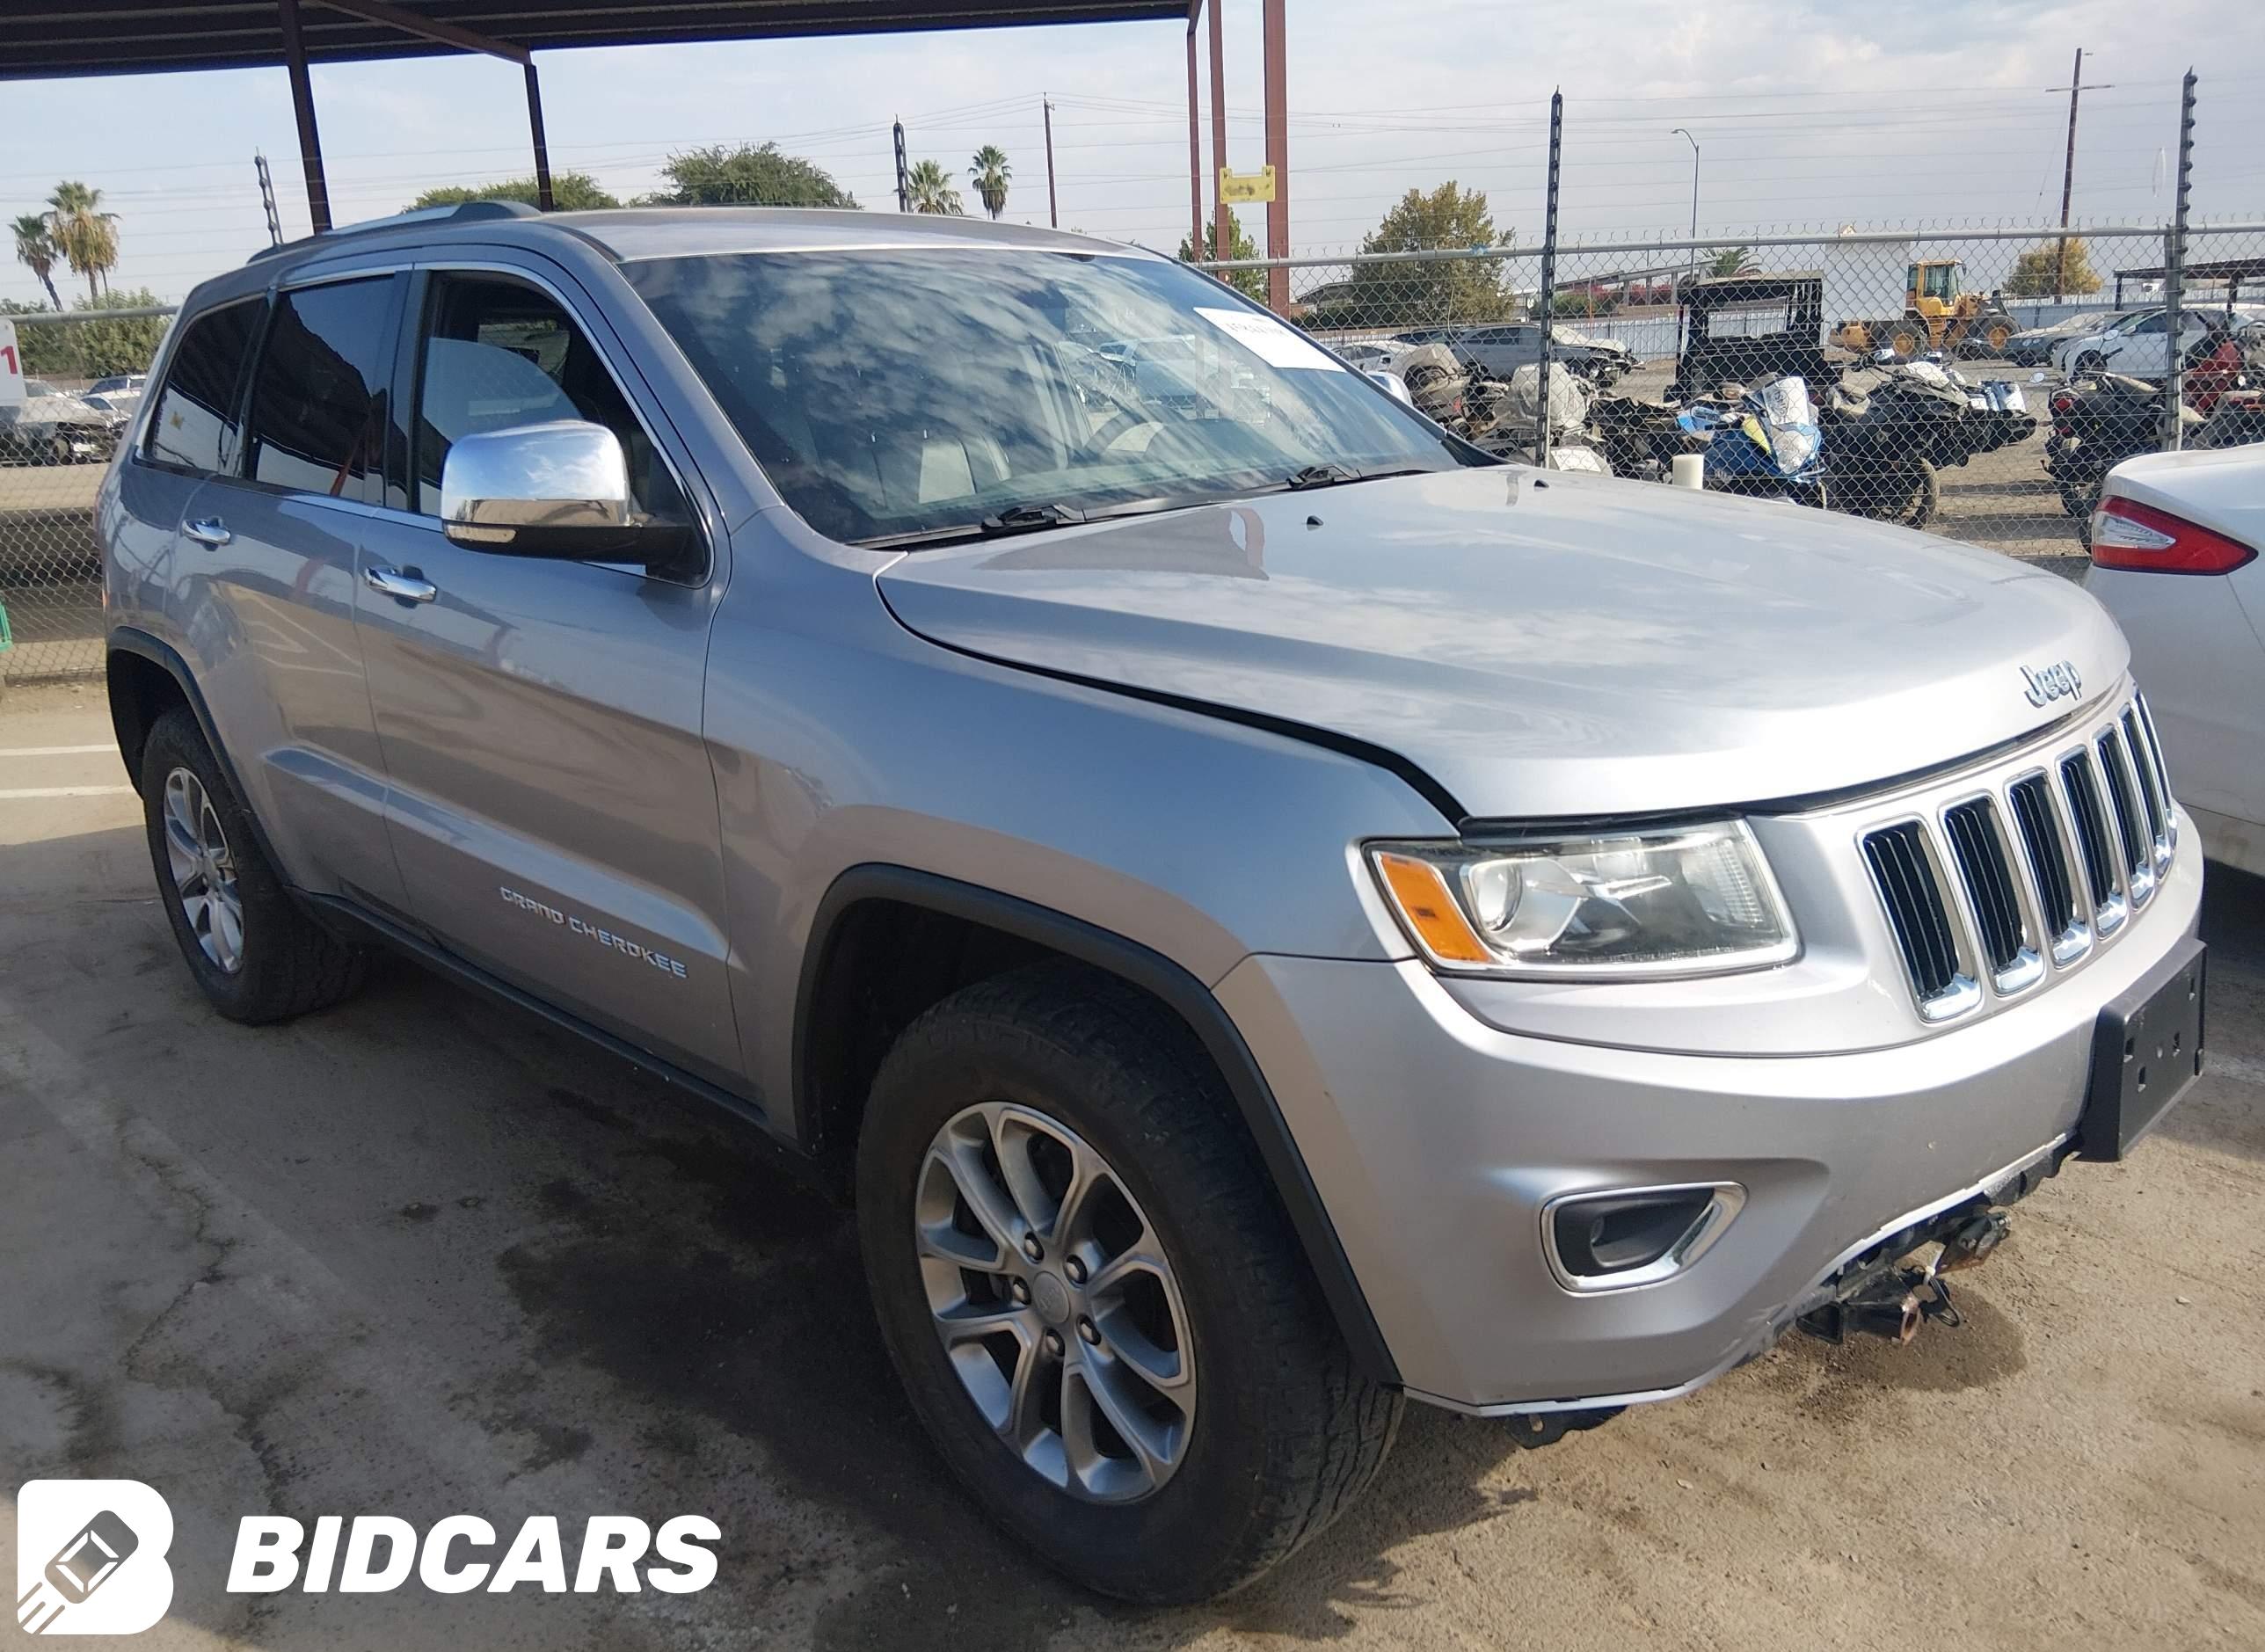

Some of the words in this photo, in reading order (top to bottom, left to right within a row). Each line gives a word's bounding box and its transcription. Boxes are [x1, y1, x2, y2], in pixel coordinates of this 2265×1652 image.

[1, 346, 18, 375] 1
[2020, 660, 2082, 709] Jeep
[499, 886, 565, 925] GRAND
[569, 916, 688, 979] CHEROKEE
